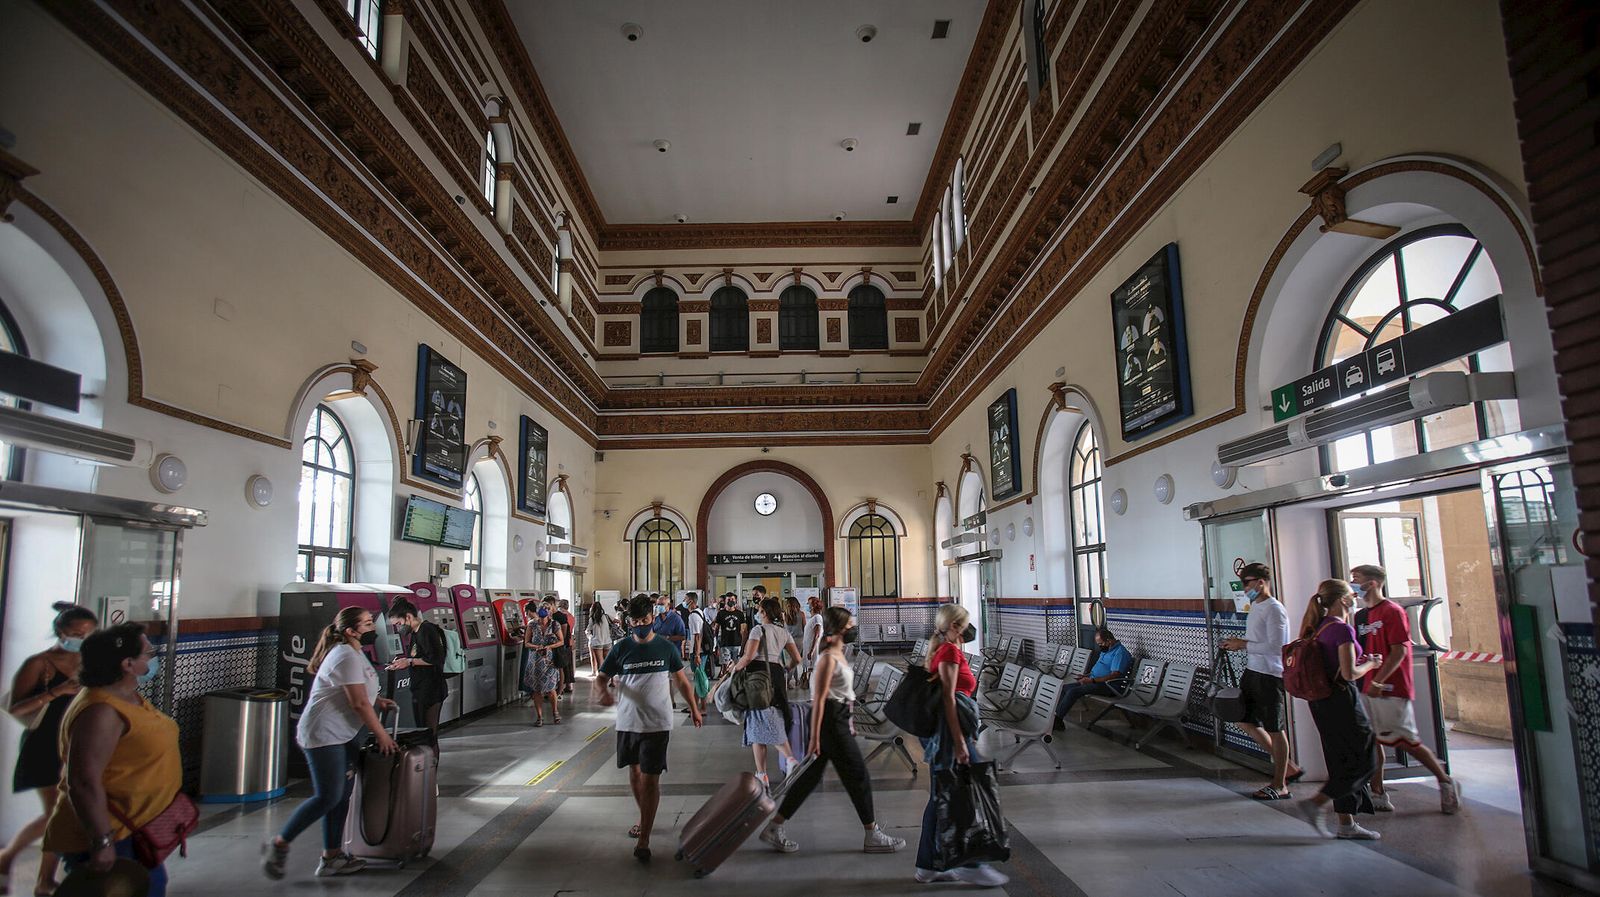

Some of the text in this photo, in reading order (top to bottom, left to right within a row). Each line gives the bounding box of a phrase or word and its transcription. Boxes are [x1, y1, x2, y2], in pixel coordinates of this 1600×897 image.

[1302, 377, 1331, 397] Salida
[1303, 397, 1315, 407] EXIT
[282, 634, 310, 720] renfe
